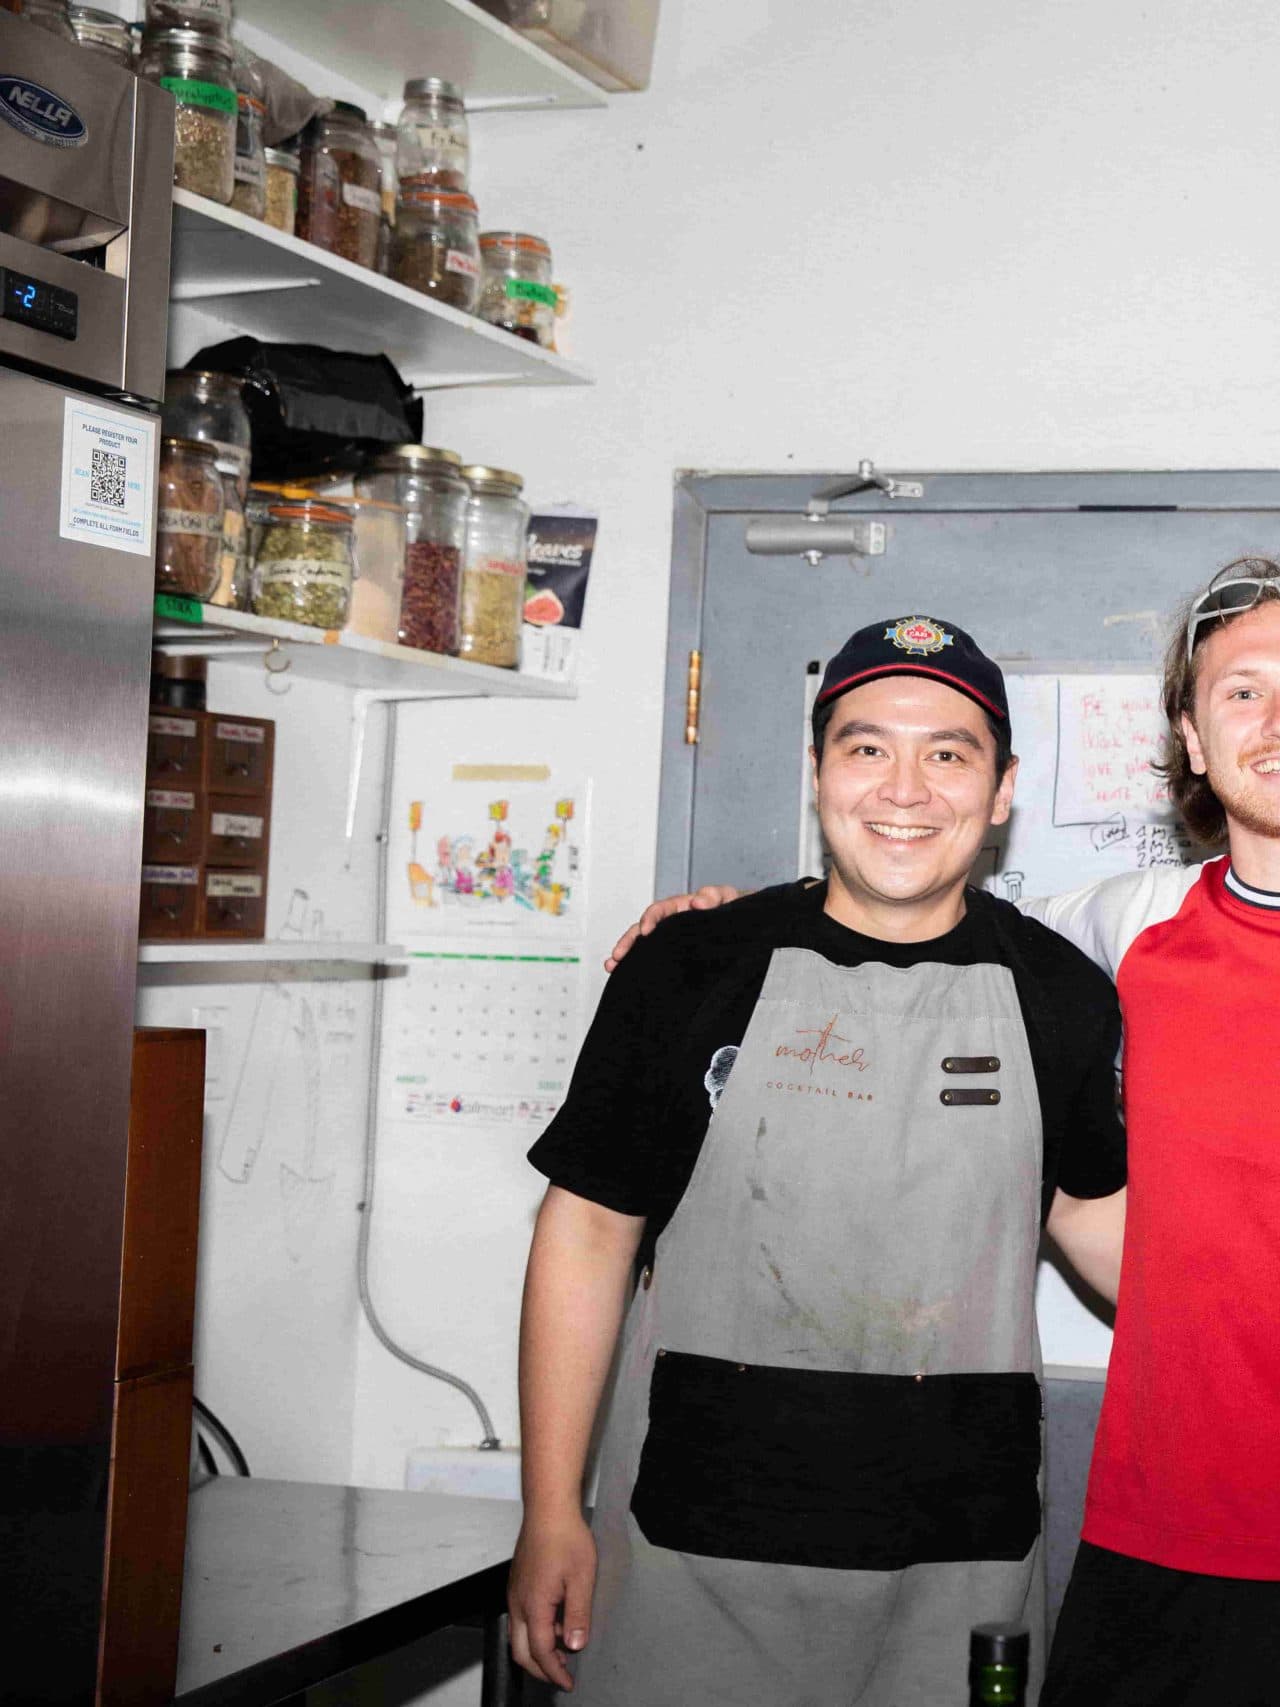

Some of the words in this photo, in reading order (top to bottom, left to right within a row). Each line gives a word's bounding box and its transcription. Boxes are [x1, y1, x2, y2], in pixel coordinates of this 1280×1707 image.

[9, 86, 72, 126] NELLA
[15, 285, 36, 308] -2
[99, 437, 121, 449] PRODUCT
[73, 516, 101, 529] COMPLETE
[100, 523, 109, 531] ALL
[122, 528, 139, 537] FIELDS
[774, 1013, 871, 1077] mother
[767, 1081, 837, 1097] COCKTAIL
[847, 1091, 874, 1102] BAR
